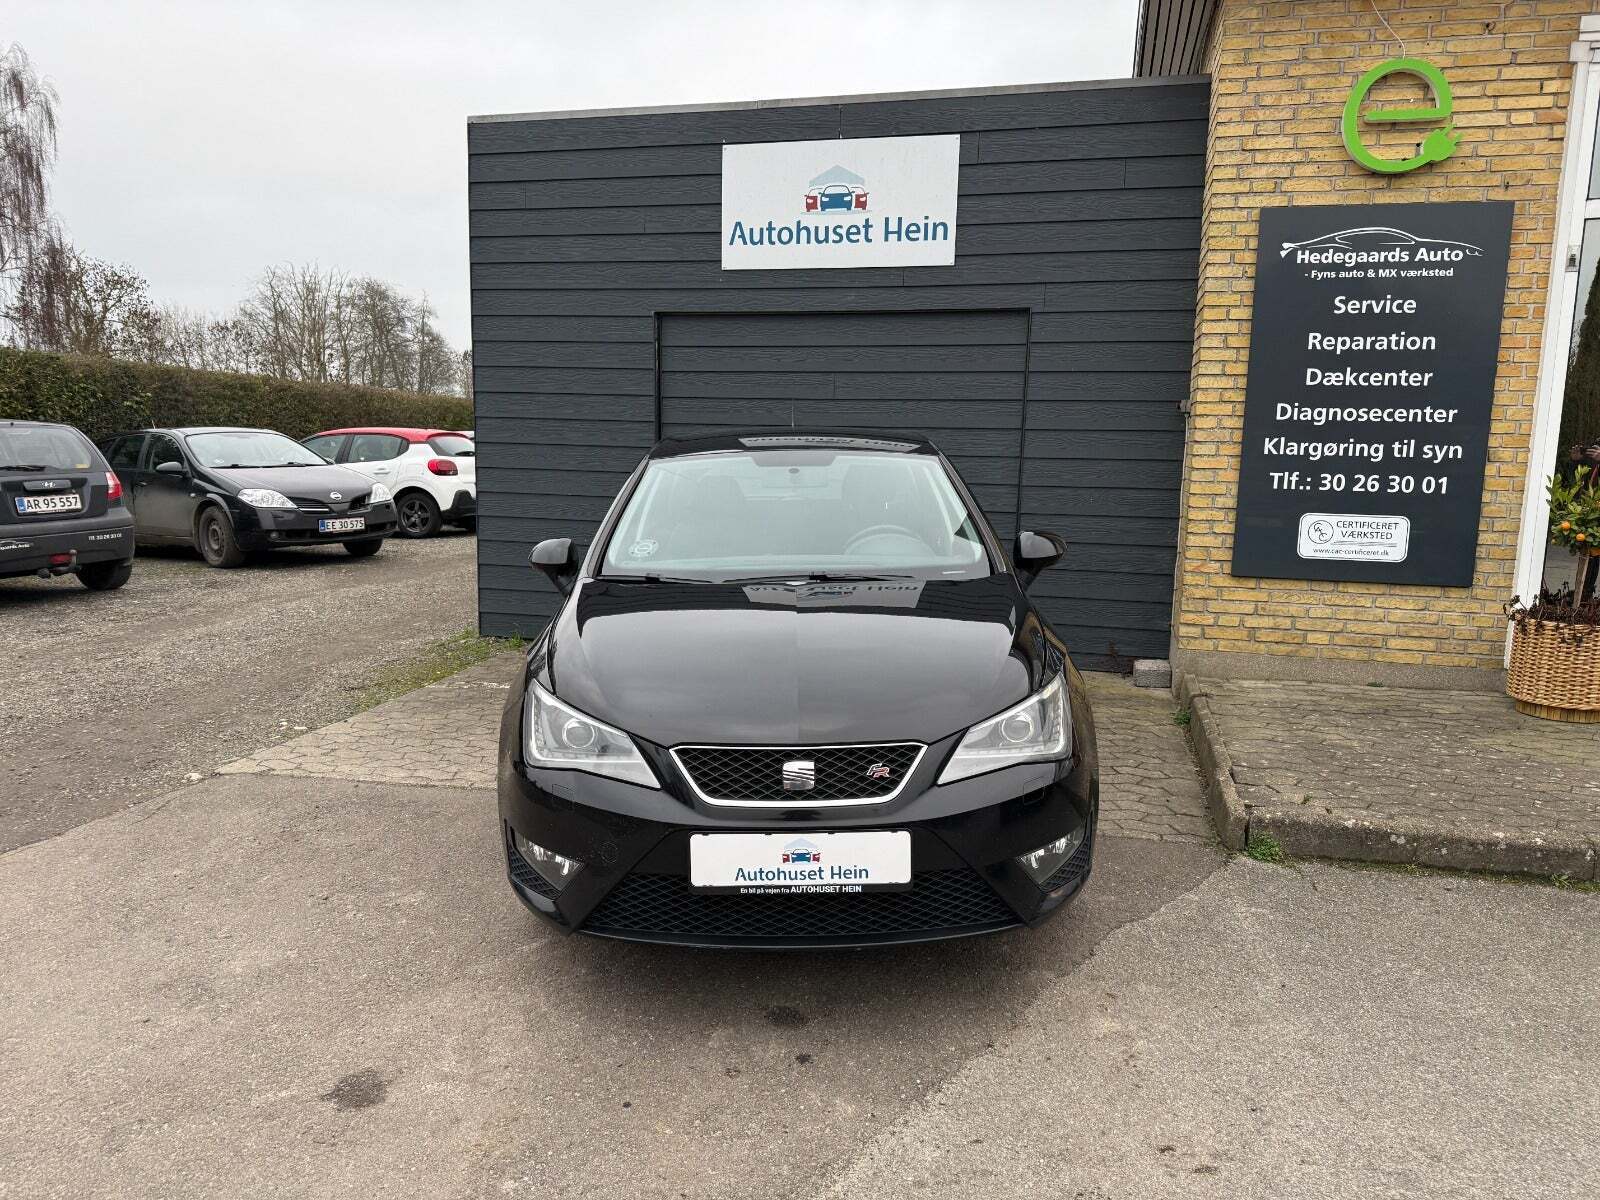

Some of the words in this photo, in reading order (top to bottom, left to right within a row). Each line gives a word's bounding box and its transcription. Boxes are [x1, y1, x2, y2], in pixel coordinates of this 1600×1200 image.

[729, 217, 874, 246] Autohuset
[883, 215, 949, 242] Hein
[1296, 247, 1410, 267] Hedegaards
[1414, 246, 1464, 262] Auto
[1310, 269, 1336, 280] Fyns
[1338, 269, 1365, 279] auto
[1367, 268, 1376, 278] &
[1378, 268, 1398, 278] MX
[1400, 267, 1454, 278] værksted
[1333, 294, 1417, 314] Service
[1307, 331, 1436, 355] Reparation
[1305, 367, 1434, 387] Dækcenter
[1275, 402, 1458, 426] Diagnosecenter
[1263, 437, 1384, 463] Klargøring
[1391, 439, 1416, 458] til
[1422, 444, 1463, 464] syn
[1269, 471, 1312, 490] Tlf.:
[1319, 473, 1346, 491] 30
[1352, 474, 1380, 492] 26
[1387, 475, 1415, 494] 30
[1421, 476, 1448, 495] 01
[26, 499, 41, 510] AR
[43, 498, 57, 509] 95
[59, 496, 78, 508] 557
[326, 521, 337, 530] EE
[339, 521, 349, 529] 30
[350, 519, 364, 529] 575
[1336, 520, 1399, 531] CERTIFICERET
[1340, 530, 1393, 540] VÆRKSTED
[734, 866, 825, 882] Autohuset
[829, 865, 869, 880] Hein
[790, 885, 840, 893] AUTOHUSET
[842, 885, 862, 893] HEIN
